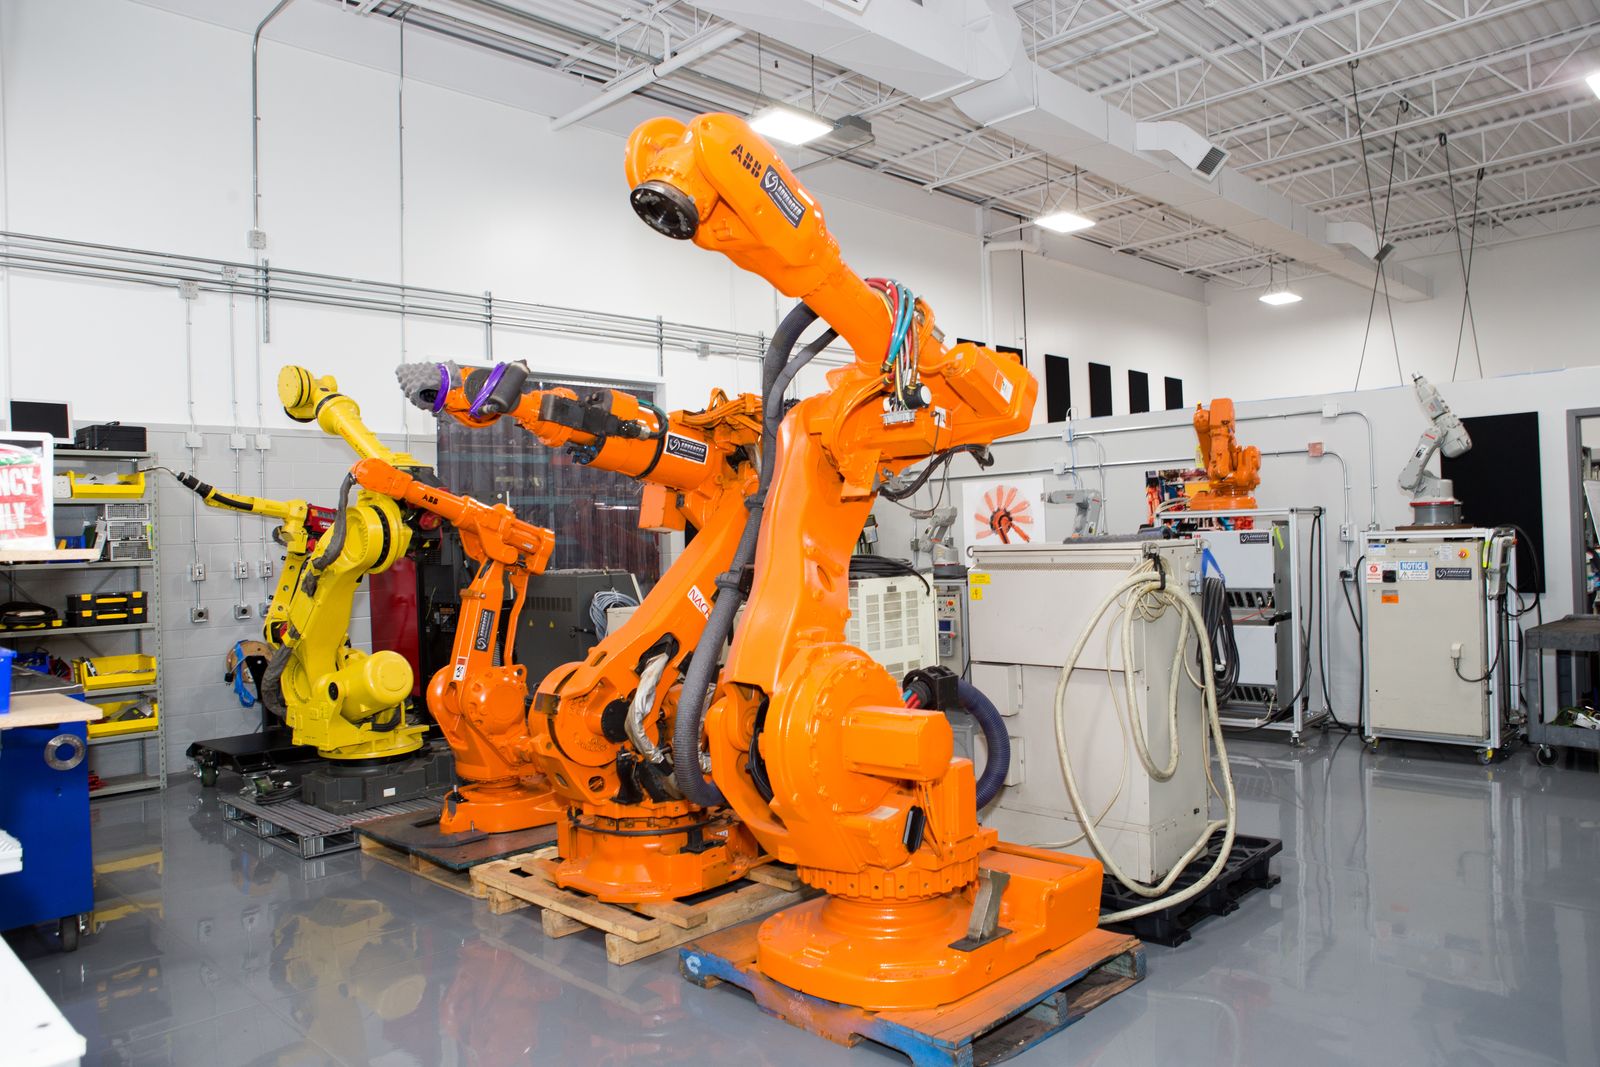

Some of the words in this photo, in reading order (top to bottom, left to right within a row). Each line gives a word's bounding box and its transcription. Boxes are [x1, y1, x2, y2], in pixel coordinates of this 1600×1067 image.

[731, 144, 761, 178] ABB
[777, 185, 802, 216] ADVANCED
[422, 494, 438, 504] ABB
[1401, 562, 1426, 570] NOTICE
